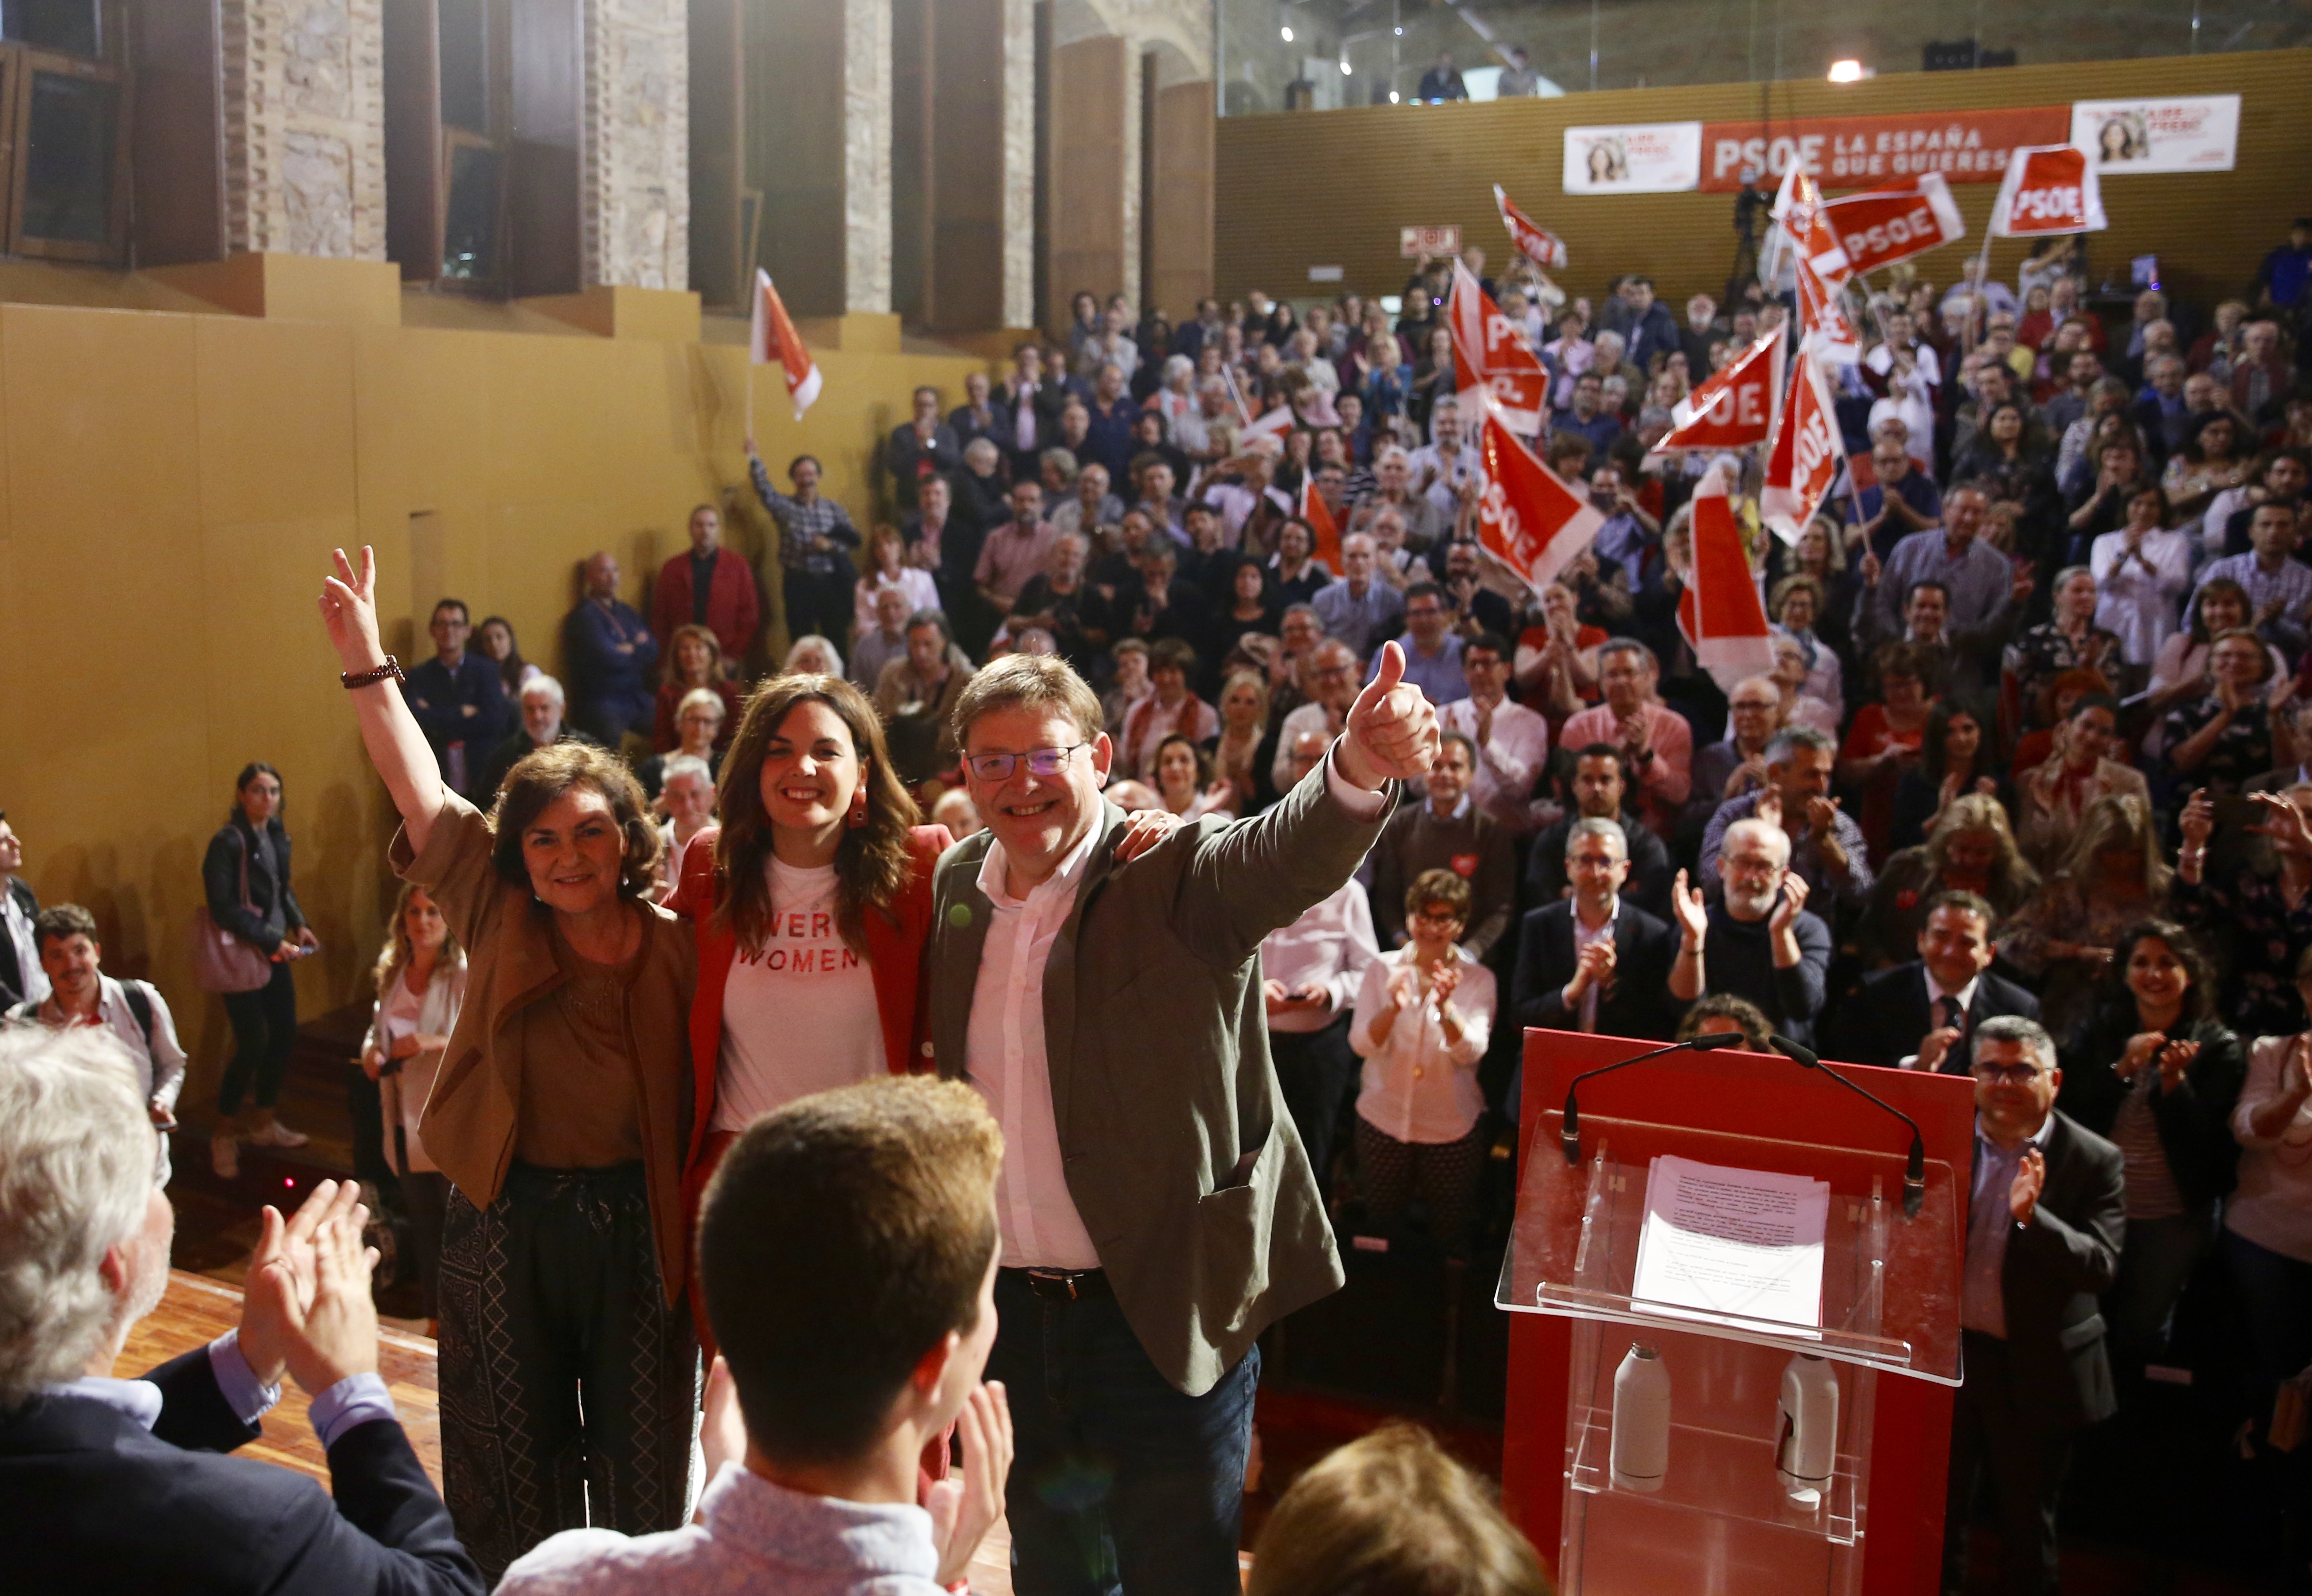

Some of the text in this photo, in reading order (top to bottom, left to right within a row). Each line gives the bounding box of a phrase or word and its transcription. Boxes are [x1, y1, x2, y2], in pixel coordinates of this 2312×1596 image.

[1834, 123, 1983, 156] LA ESPAÑA
[1714, 134, 1826, 180] PSOE
[1832, 148, 2010, 177] QUE QUIERES
[2011, 187, 2081, 221] PSOE
[1843, 205, 1935, 263] PSOE
[739, 948, 858, 972] WOMEN
